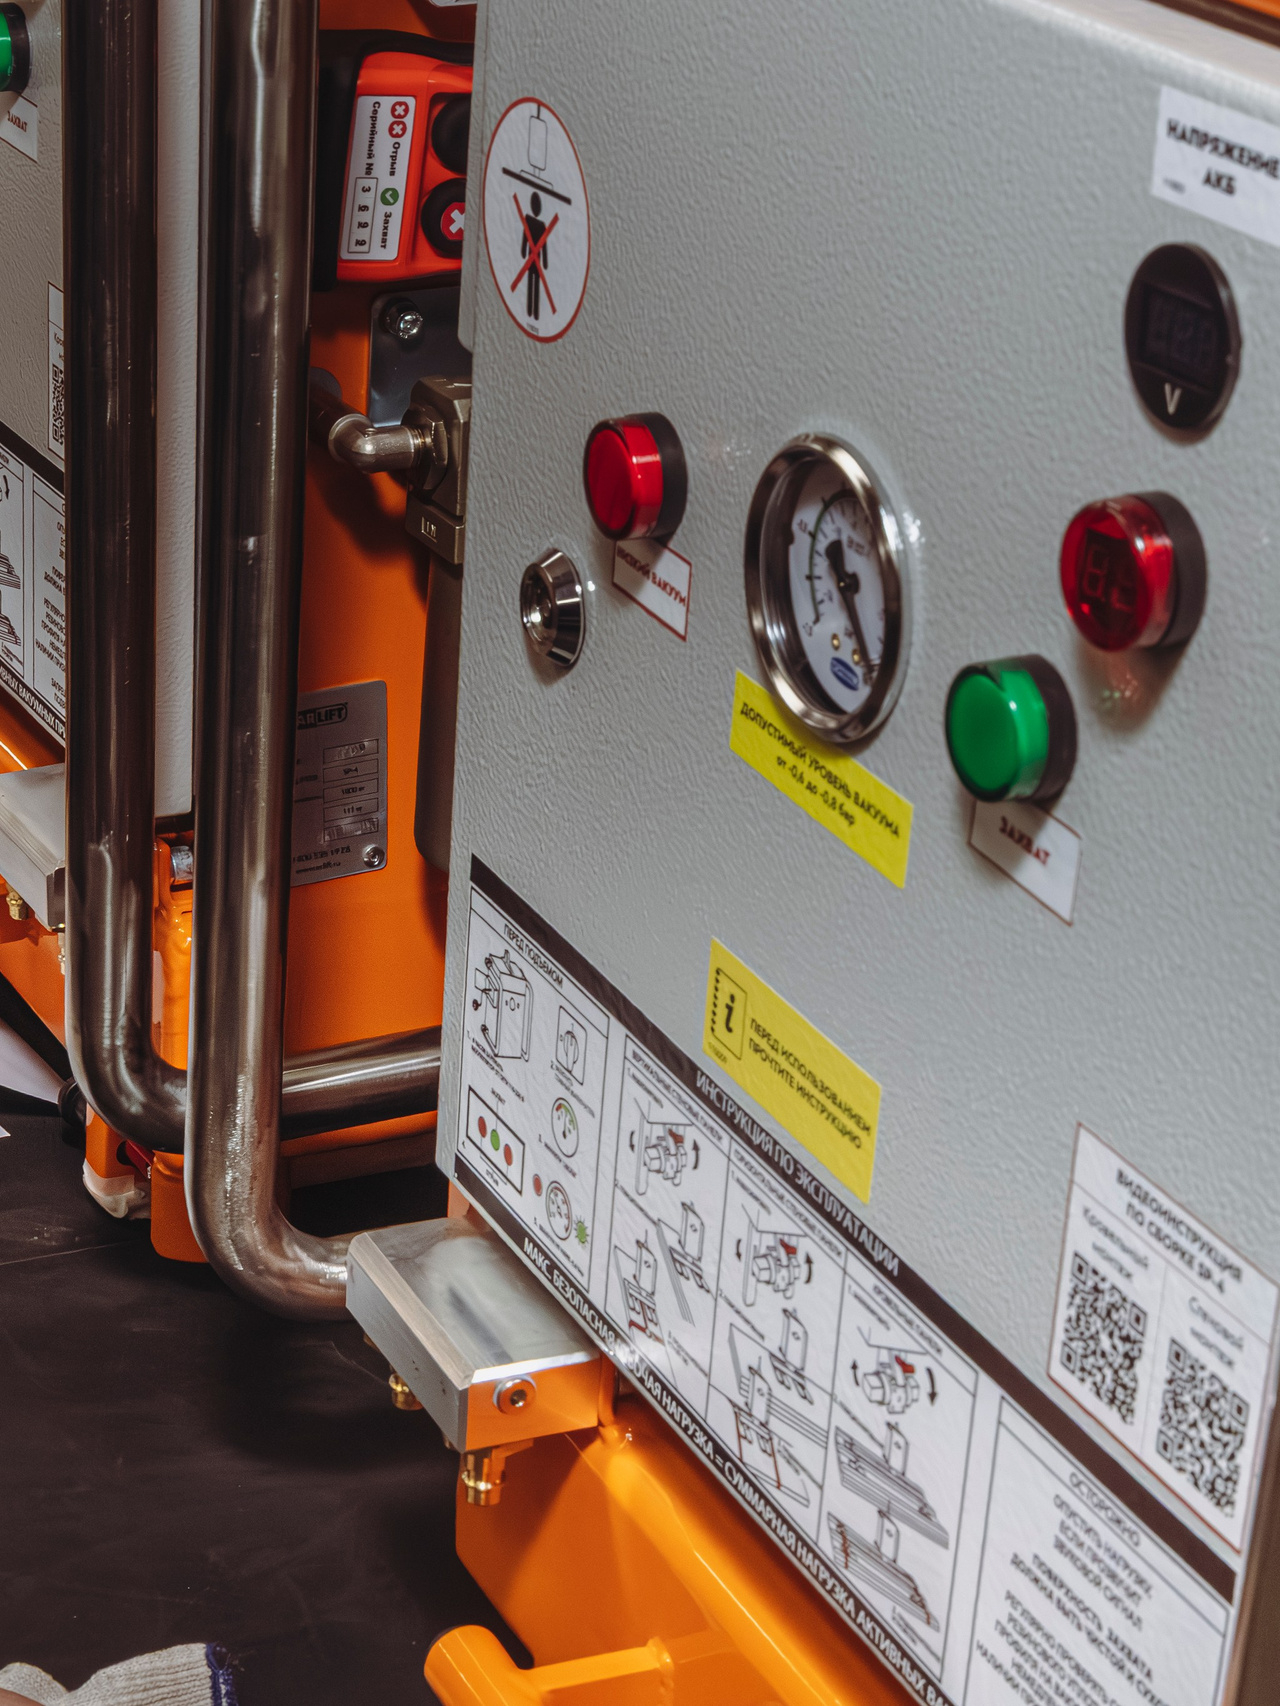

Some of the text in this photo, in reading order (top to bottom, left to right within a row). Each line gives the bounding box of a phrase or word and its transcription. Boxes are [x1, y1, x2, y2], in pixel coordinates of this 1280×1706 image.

[367, 101, 380, 159] Серийный
[389, 142, 400, 176] Отрыв
[1167, 117, 1280, 180] НАПРЯЖЕНИЕ
[365, 163, 374, 175] №
[1203, 166, 1237, 197] АКБ
[381, 212, 392, 249] Захват
[1164, 382, 1182, 415] V
[740, 697, 900, 839] ДОПУСТИМЫЙ УРОВЕНЬ ВАКУУМА
[776, 753, 787, 771] от
[837, 800, 855, 830] бар
[1000, 815, 1051, 866] ЗАХВАТ
[504, 922, 563, 991] ПЕРЕД ПОДЪЕМОМ
[748, 1035, 795, 1090] ПРОЧТИТЕ
[795, 1079, 862, 1153] ИНСТРУКЦИЮ
[750, 1016, 871, 1138] ПЕРЕД ИСПОЛЬЗОВАНИЕМ
[695, 1067, 773, 1161] ИНСТРУКЦИЯ
[774, 1141, 794, 1180] ПО
[794, 1160, 899, 1282] ЭКСПЛУАТАЦИИ
[1081, 1202, 1149, 1274] Кровельный
[1115, 1166, 1242, 1285] ВИДЕОИНСТРУКЦИЯ
[1126, 1199, 1145, 1229] ПО
[1146, 1217, 1195, 1271] СБОРКЕ
[1187, 1291, 1245, 1355] Стеновой
[523, 1234, 552, 1281] МАКС.
[552, 1266, 614, 1351] БЕЗОПАСНАЯ
[662, 1387, 713, 1461] НАГРУЗКА
[724, 1457, 795, 1553] СУММАРНАЯ
[796, 1537, 855, 1621] НАГРУЗКА
[856, 1603, 926, 1699] АКТИВНЫХ
[1052, 1489, 1102, 1552] ОПУСТИТЬ
[1069, 1468, 1141, 1551] ОСТОРОЖНО
[1031, 1549, 1153, 1684] ПОВЕРХНОСТЬ ЗАХВАТА
